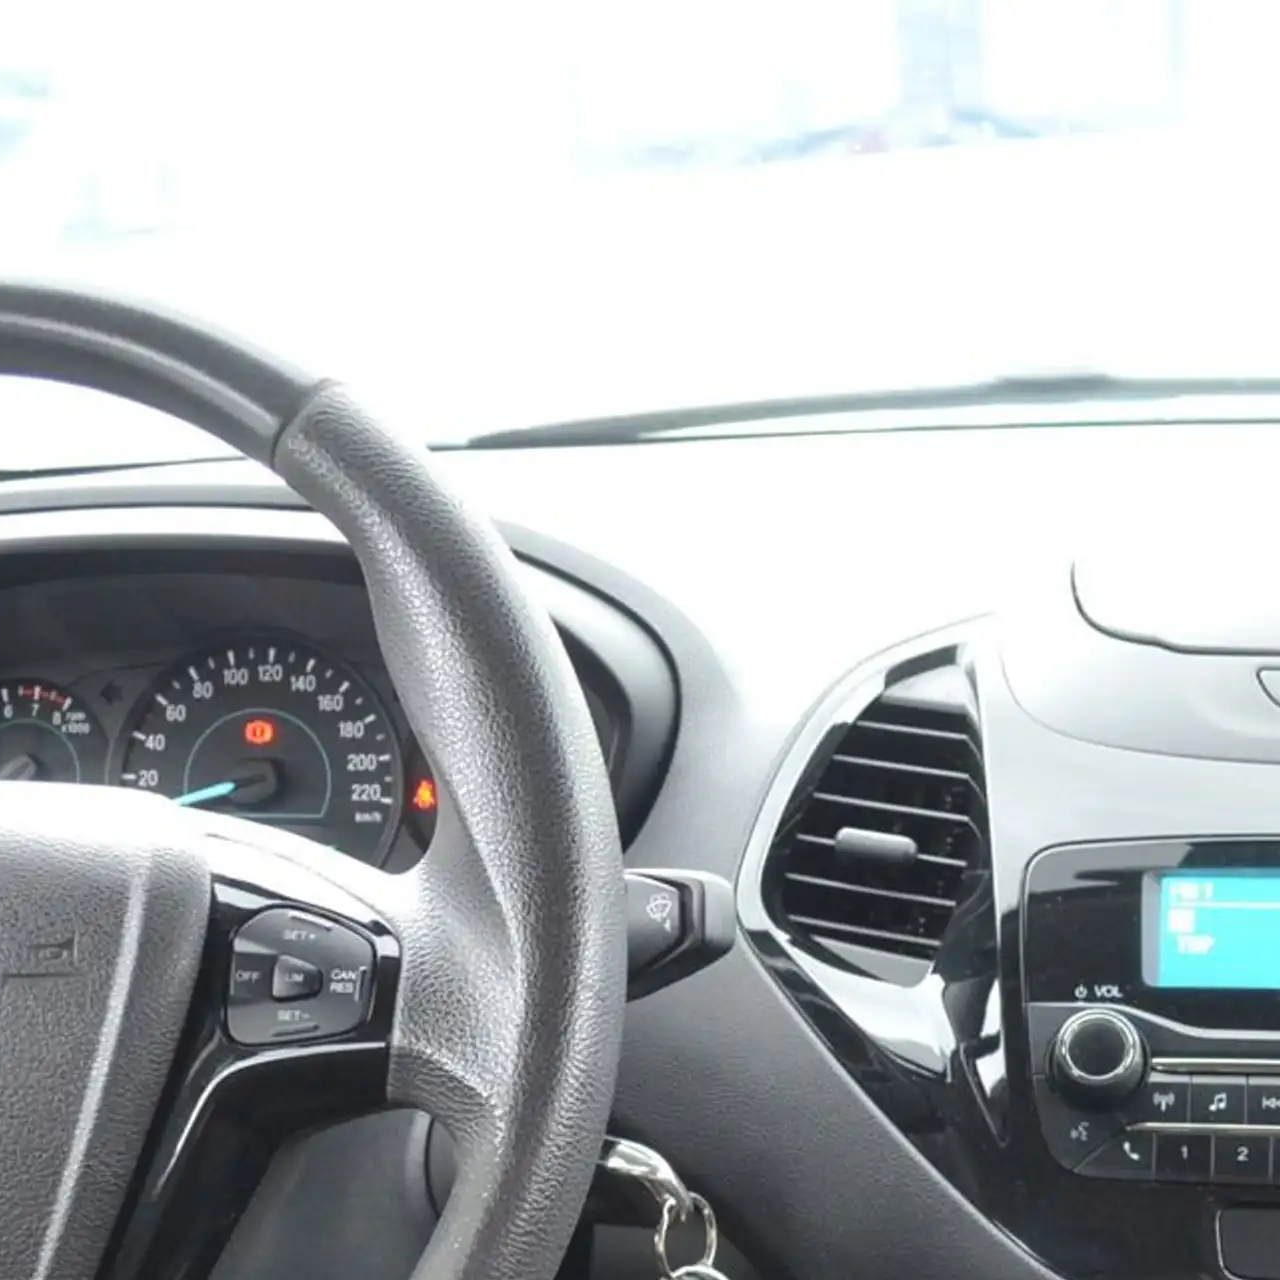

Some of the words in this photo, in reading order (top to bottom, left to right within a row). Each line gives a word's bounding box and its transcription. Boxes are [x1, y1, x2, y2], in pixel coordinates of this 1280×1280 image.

[223, 669, 249, 685] 100
[258, 665, 282, 681] 120
[192, 681, 214, 698] 80
[290, 675, 316, 692] 140
[3, 704, 13, 718] 6
[31, 703, 40, 717] 7
[317, 694, 344, 711] 160
[165, 705, 187, 722] 60
[338, 721, 365, 738] 180
[144, 733, 165, 750] 40
[347, 754, 377, 771] 200
[138, 770, 158, 786] 20
[351, 784, 381, 801] 220
[236, 970, 262, 983] OFF
[330, 968, 357, 981] CAN
[1094, 985, 1123, 999] VOL
[1181, 1145, 1189, 1159] 1
[1236, 1147, 1249, 1162] 2
